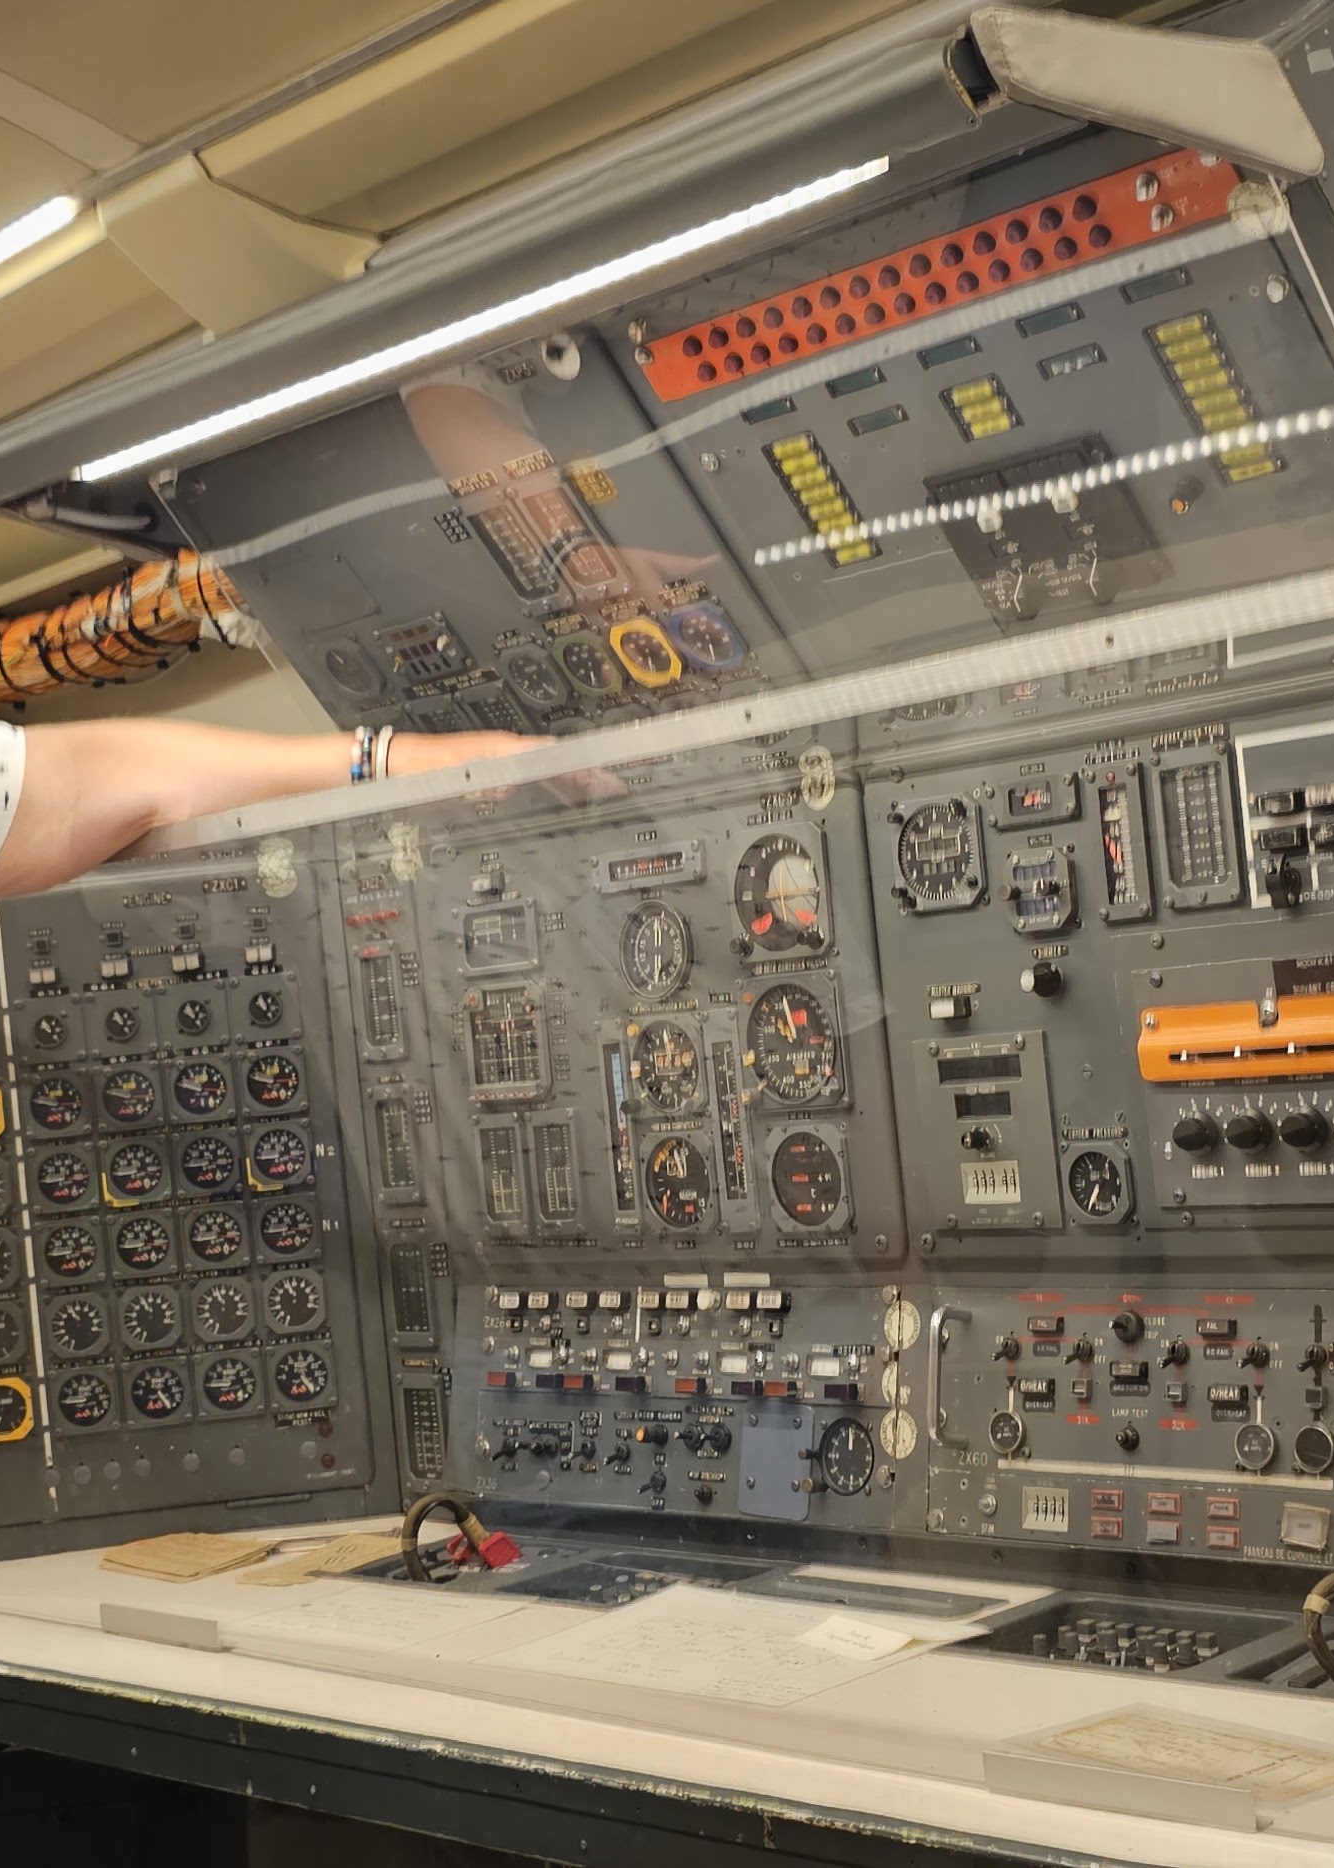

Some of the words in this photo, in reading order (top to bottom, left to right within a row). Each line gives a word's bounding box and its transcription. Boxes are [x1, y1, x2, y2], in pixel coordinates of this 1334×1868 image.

[212, 878, 238, 892] ZXC1
[316, 1144, 324, 1157] N
[322, 1219, 330, 1231] N
[484, 1316, 505, 1328] ZX26
[1144, 1316, 1165, 1326] CLOSE
[1206, 1322, 1218, 1330] FAIL
[1144, 1331, 1158, 1339] TRIP
[1095, 1338, 1103, 1346] ON
[1269, 1342, 1279, 1351] ON
[1094, 1355, 1106, 1365] OFF
[1269, 1359, 1283, 1369] OFF
[1210, 1388, 1239, 1400] O/HEAT
[1111, 1408, 1129, 1417] LAMP
[1132, 1409, 1148, 1417] TEST
[1216, 1409, 1246, 1418] OVERHEAT
[958, 1451, 988, 1467] ZX60
[1244, 1545, 1273, 1560] PANNEAU
[1276, 1548, 1285, 1560] DE
[1287, 1549, 1321, 1563] COMMANDE
[1324, 1552, 1333, 1563] ET
